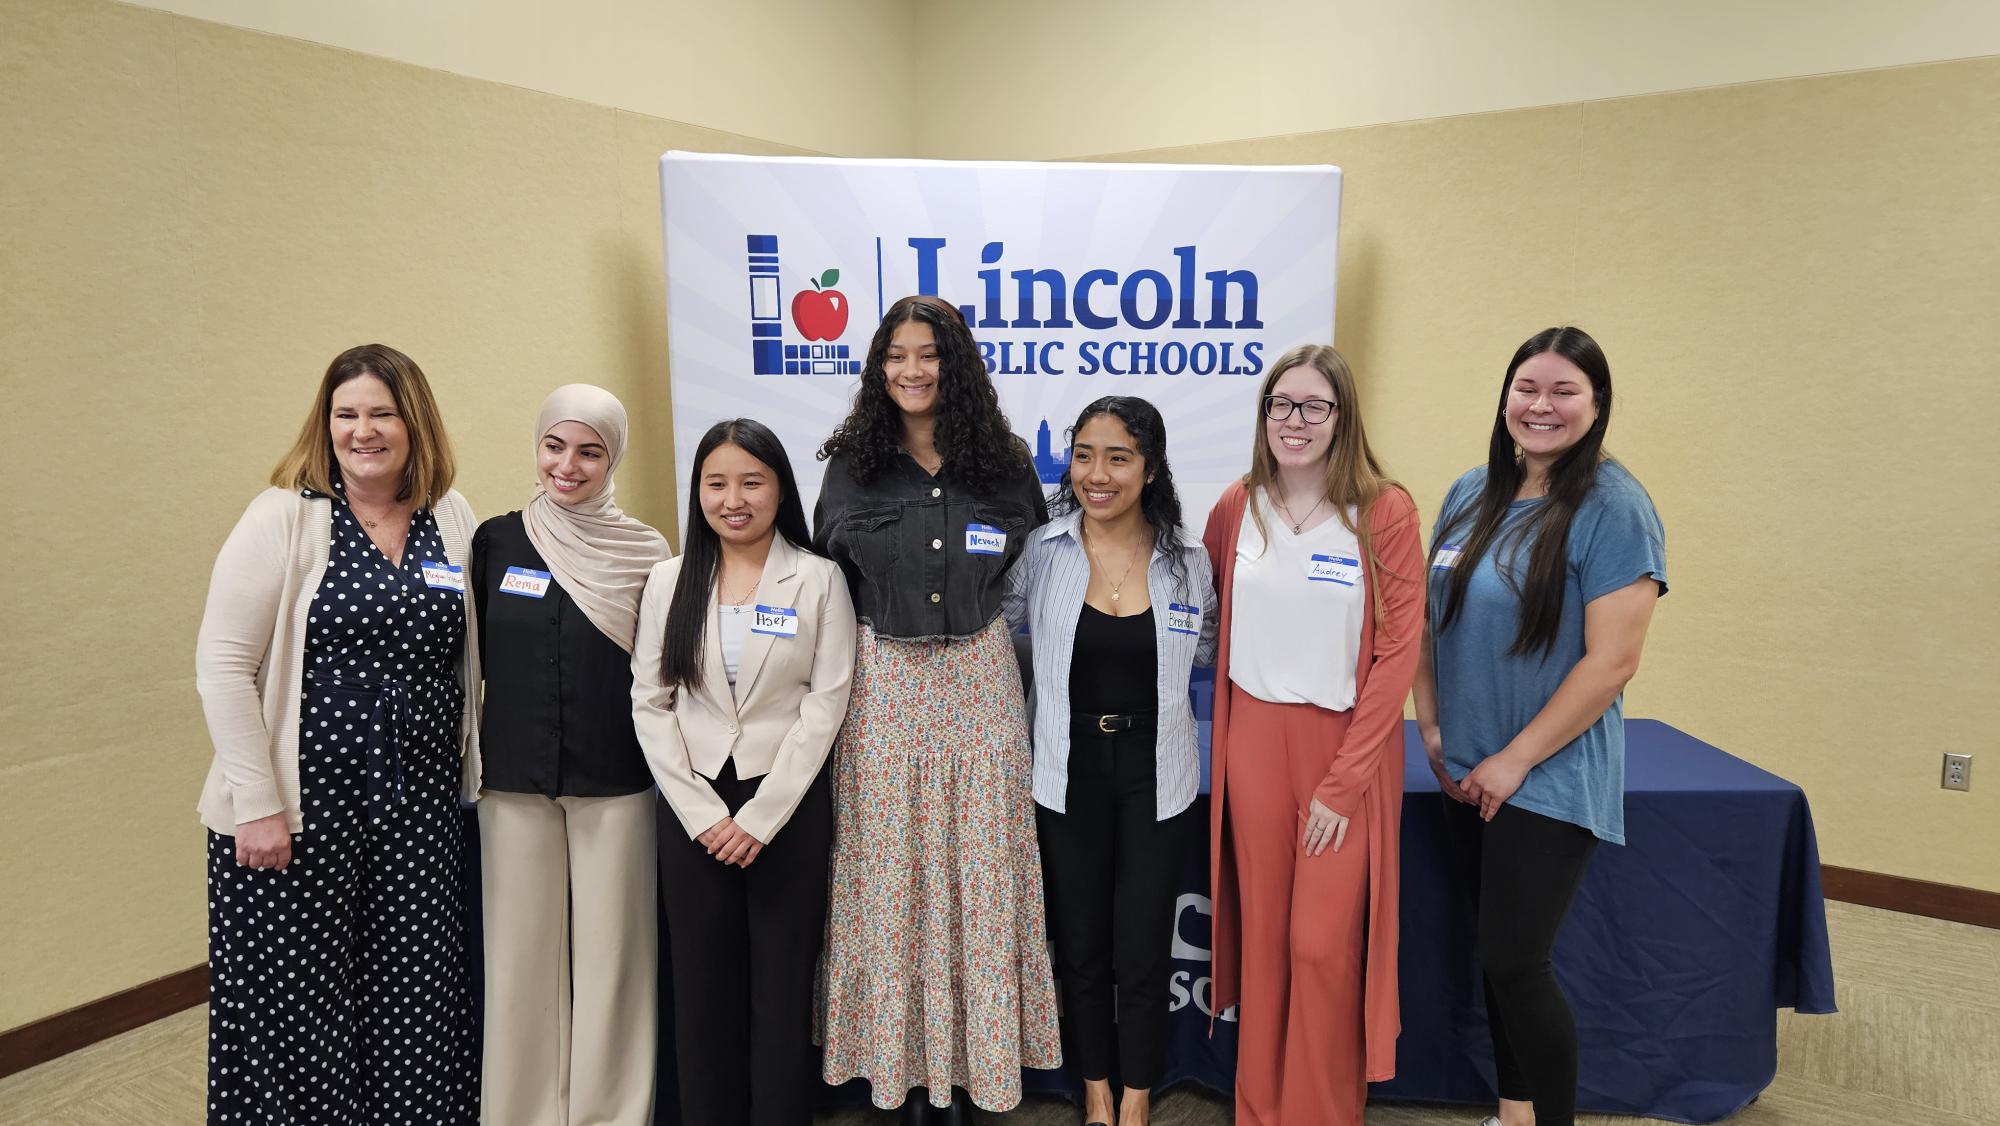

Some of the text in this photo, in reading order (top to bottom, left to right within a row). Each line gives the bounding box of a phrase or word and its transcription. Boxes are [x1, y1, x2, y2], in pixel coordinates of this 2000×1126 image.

[908, 237, 1264, 330] Lincoln
[976, 341, 1264, 376] BLIC SCHOOLS
[1312, 564, 1348, 578] Audrey
[504, 575, 541, 591] Rema
[756, 612, 788, 627] Hser
